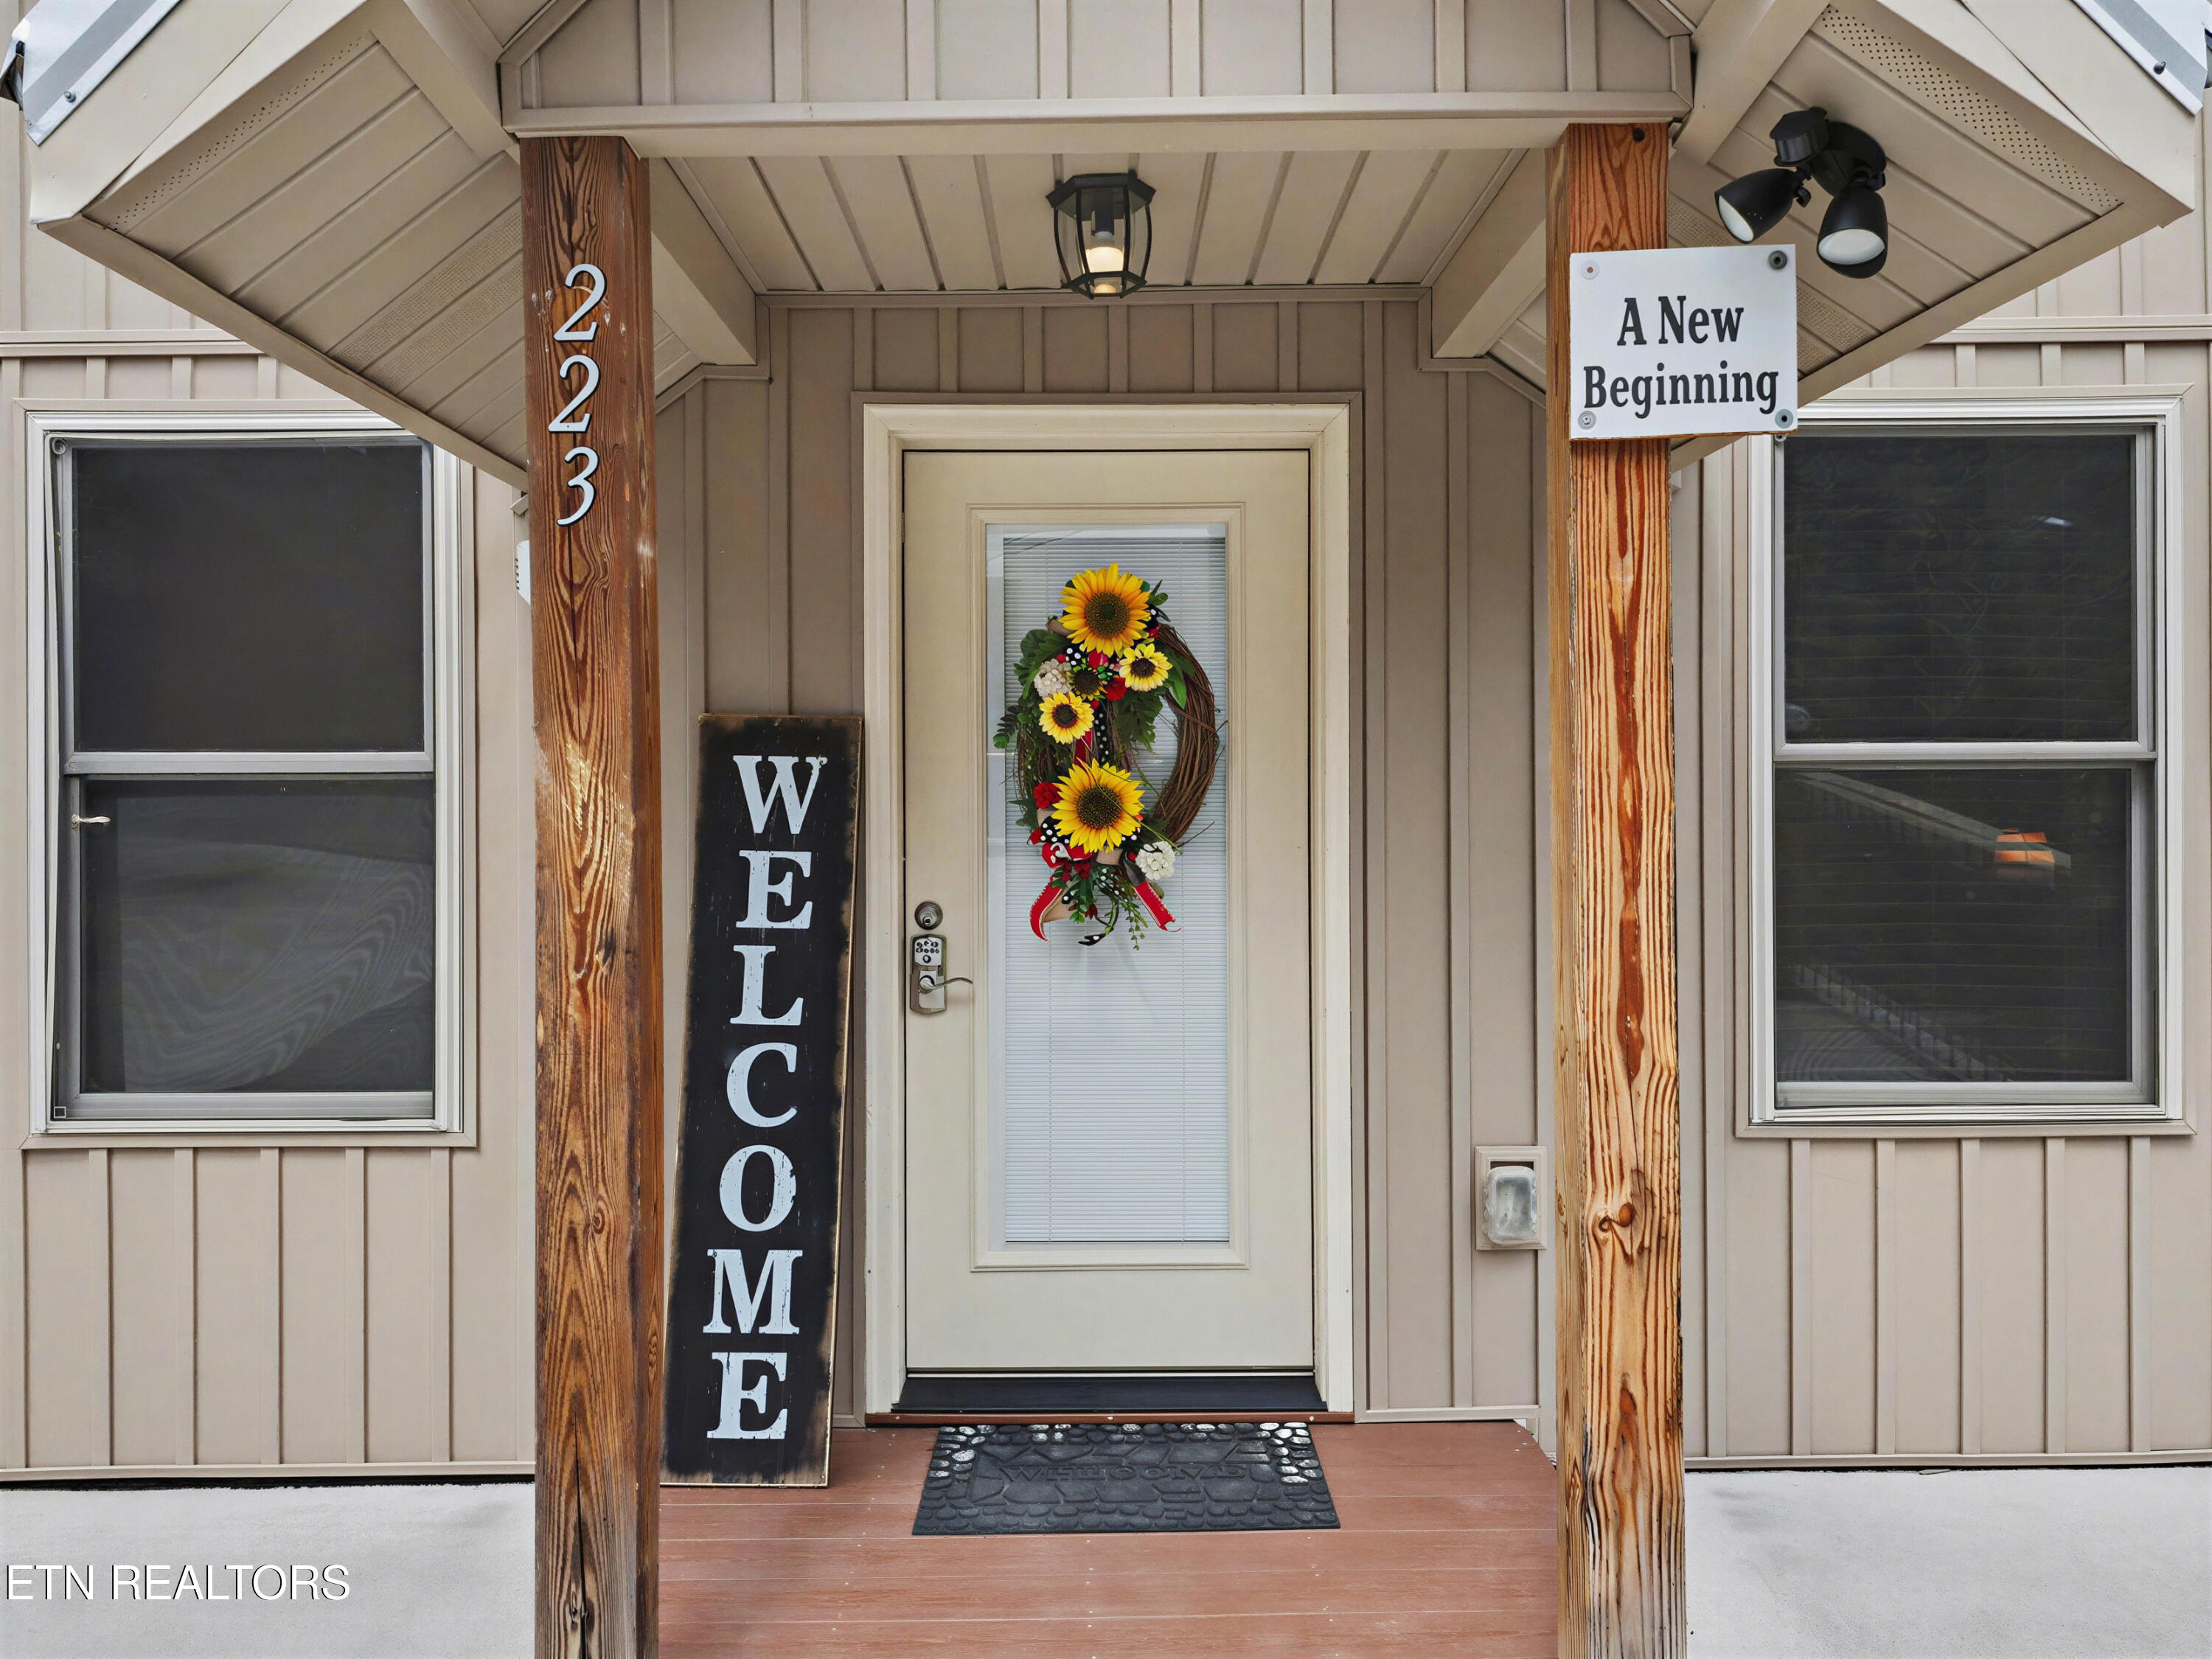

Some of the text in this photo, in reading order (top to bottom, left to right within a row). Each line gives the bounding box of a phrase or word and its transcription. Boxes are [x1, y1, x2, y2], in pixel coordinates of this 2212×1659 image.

[546, 263, 607, 526] 223
[1583, 360, 1779, 420] Beginning
[1617, 295, 1745, 346] A New
[703, 755, 829, 1440] WELCOME
